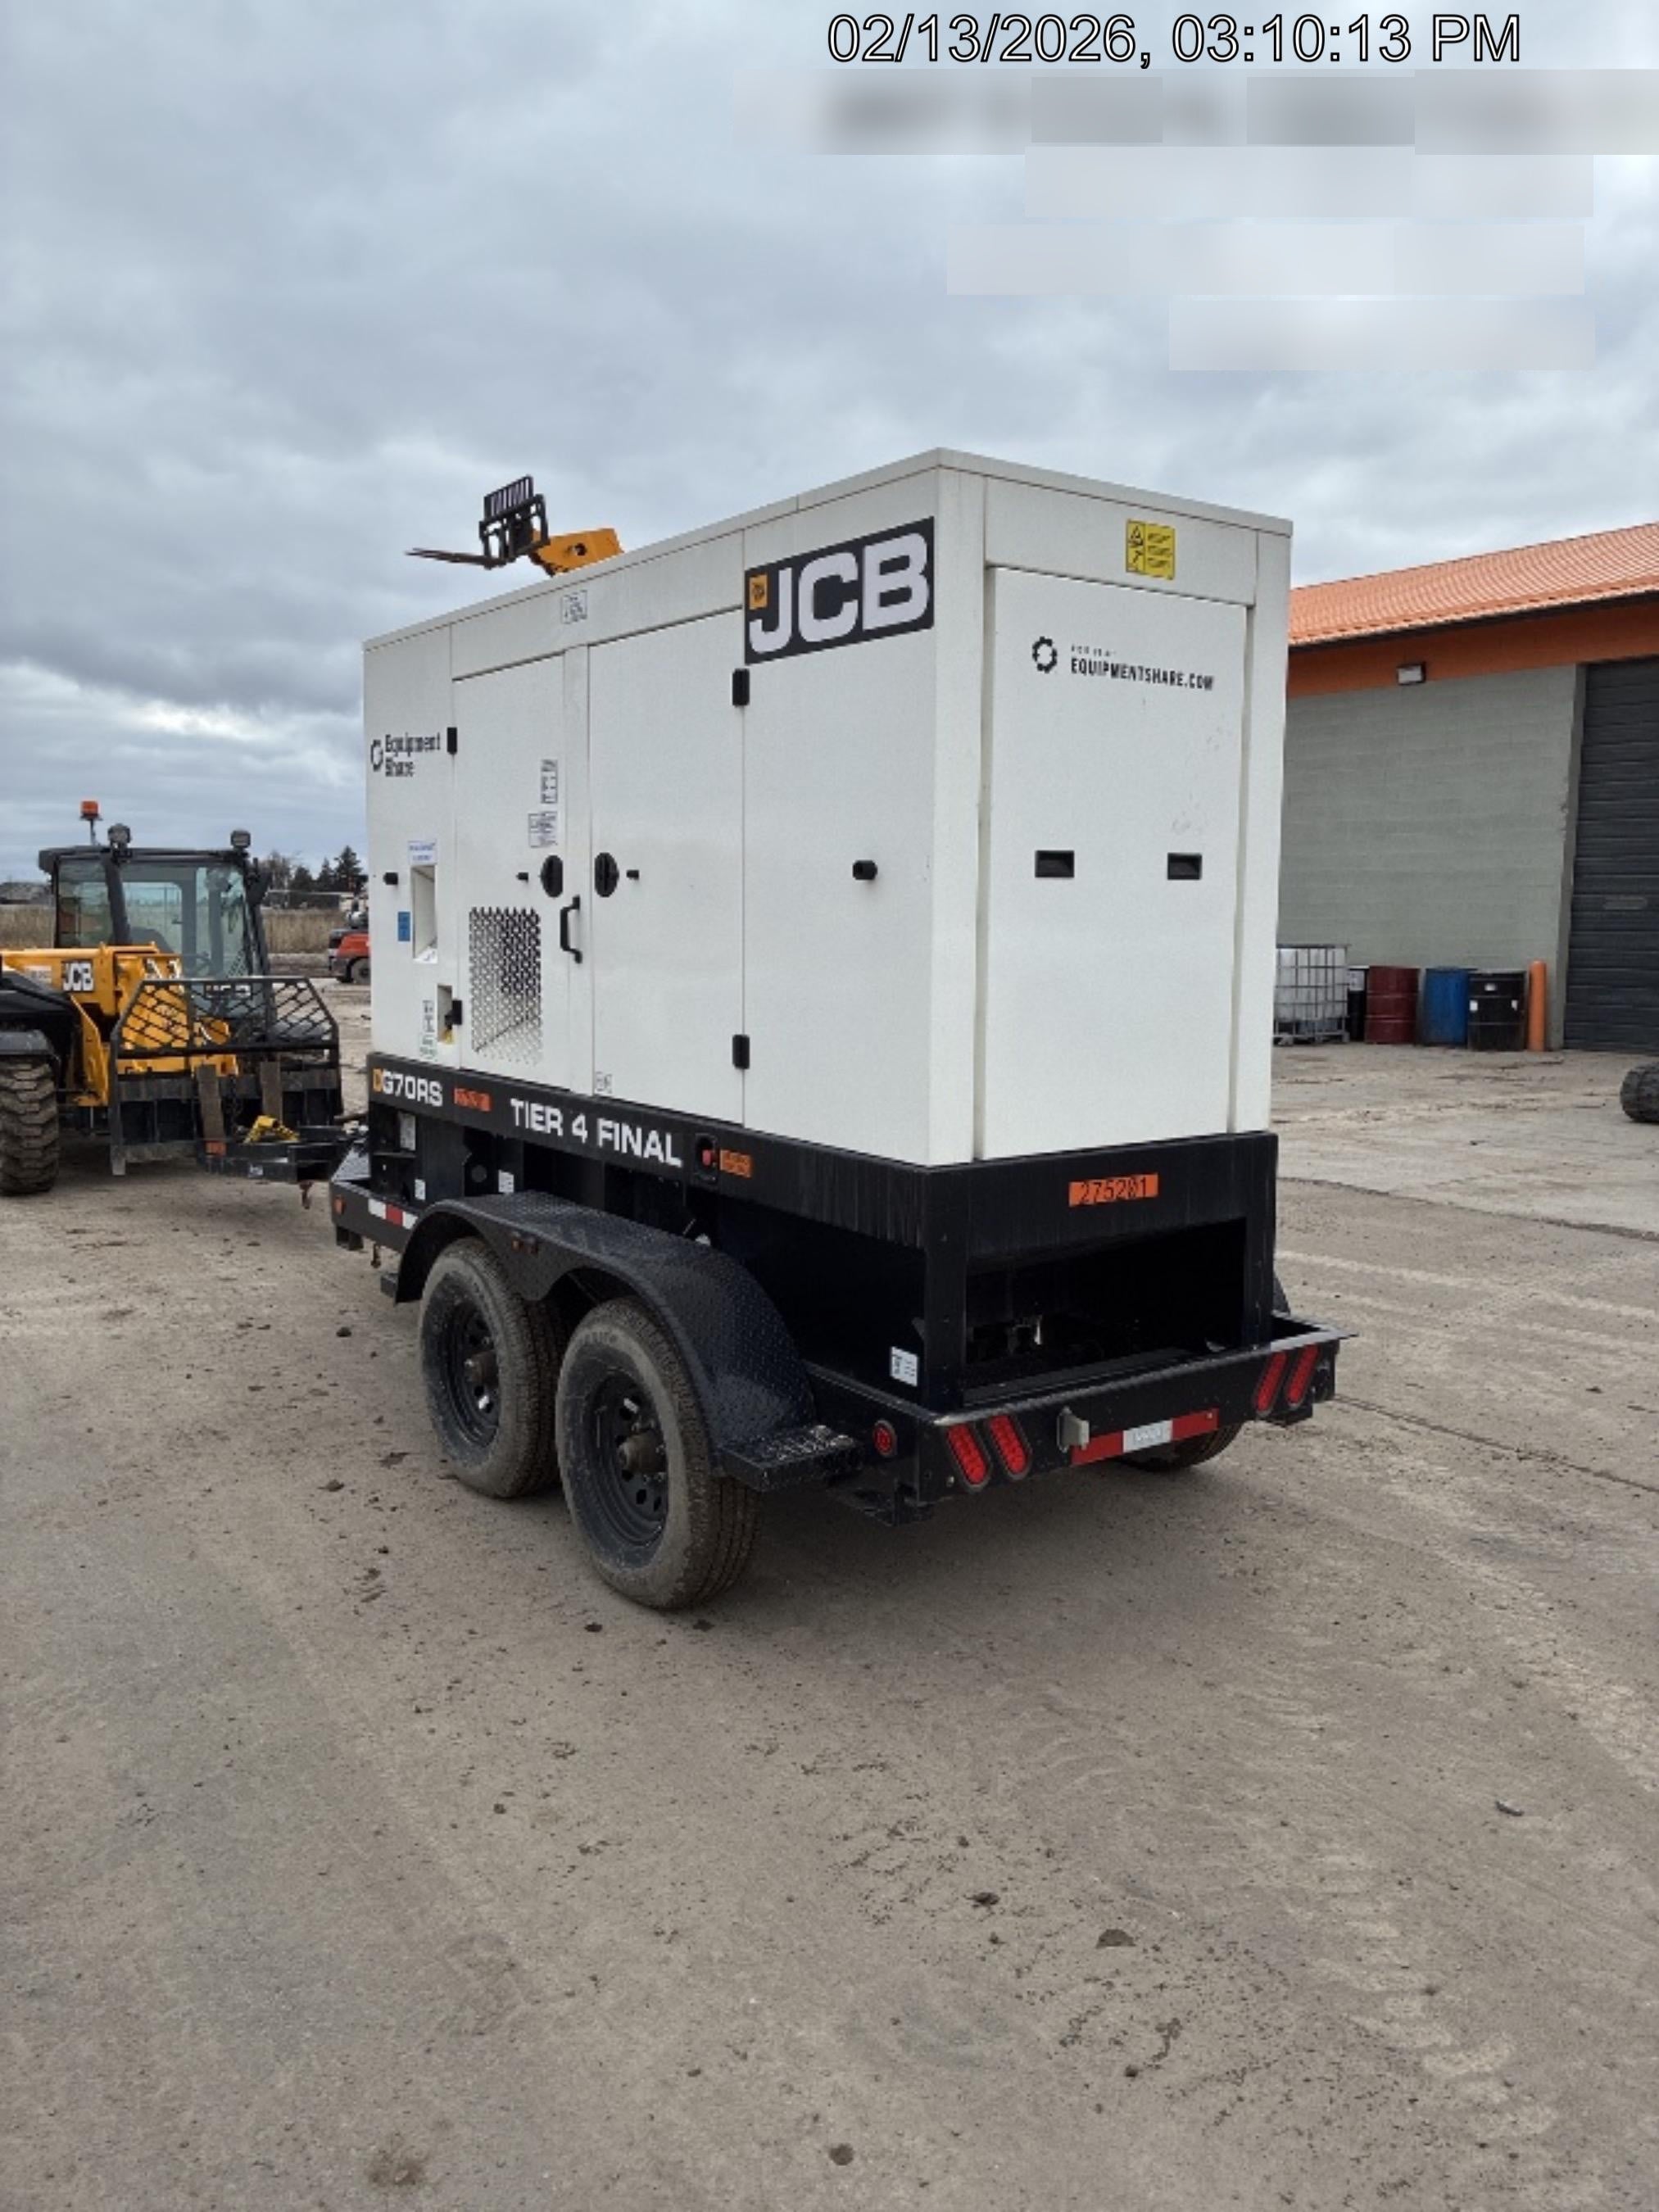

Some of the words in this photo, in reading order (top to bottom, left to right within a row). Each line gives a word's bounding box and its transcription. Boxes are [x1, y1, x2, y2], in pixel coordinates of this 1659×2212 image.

[748, 532, 930, 655] JCB
[1070, 656, 1214, 691] EQUIPMENTSHARE.COM
[384, 732, 441, 758] Equipment
[62, 961, 95, 992] JCB
[510, 1097, 564, 1137] TIER
[571, 1112, 589, 1145] 4
[596, 1117, 682, 1167] FINAL
